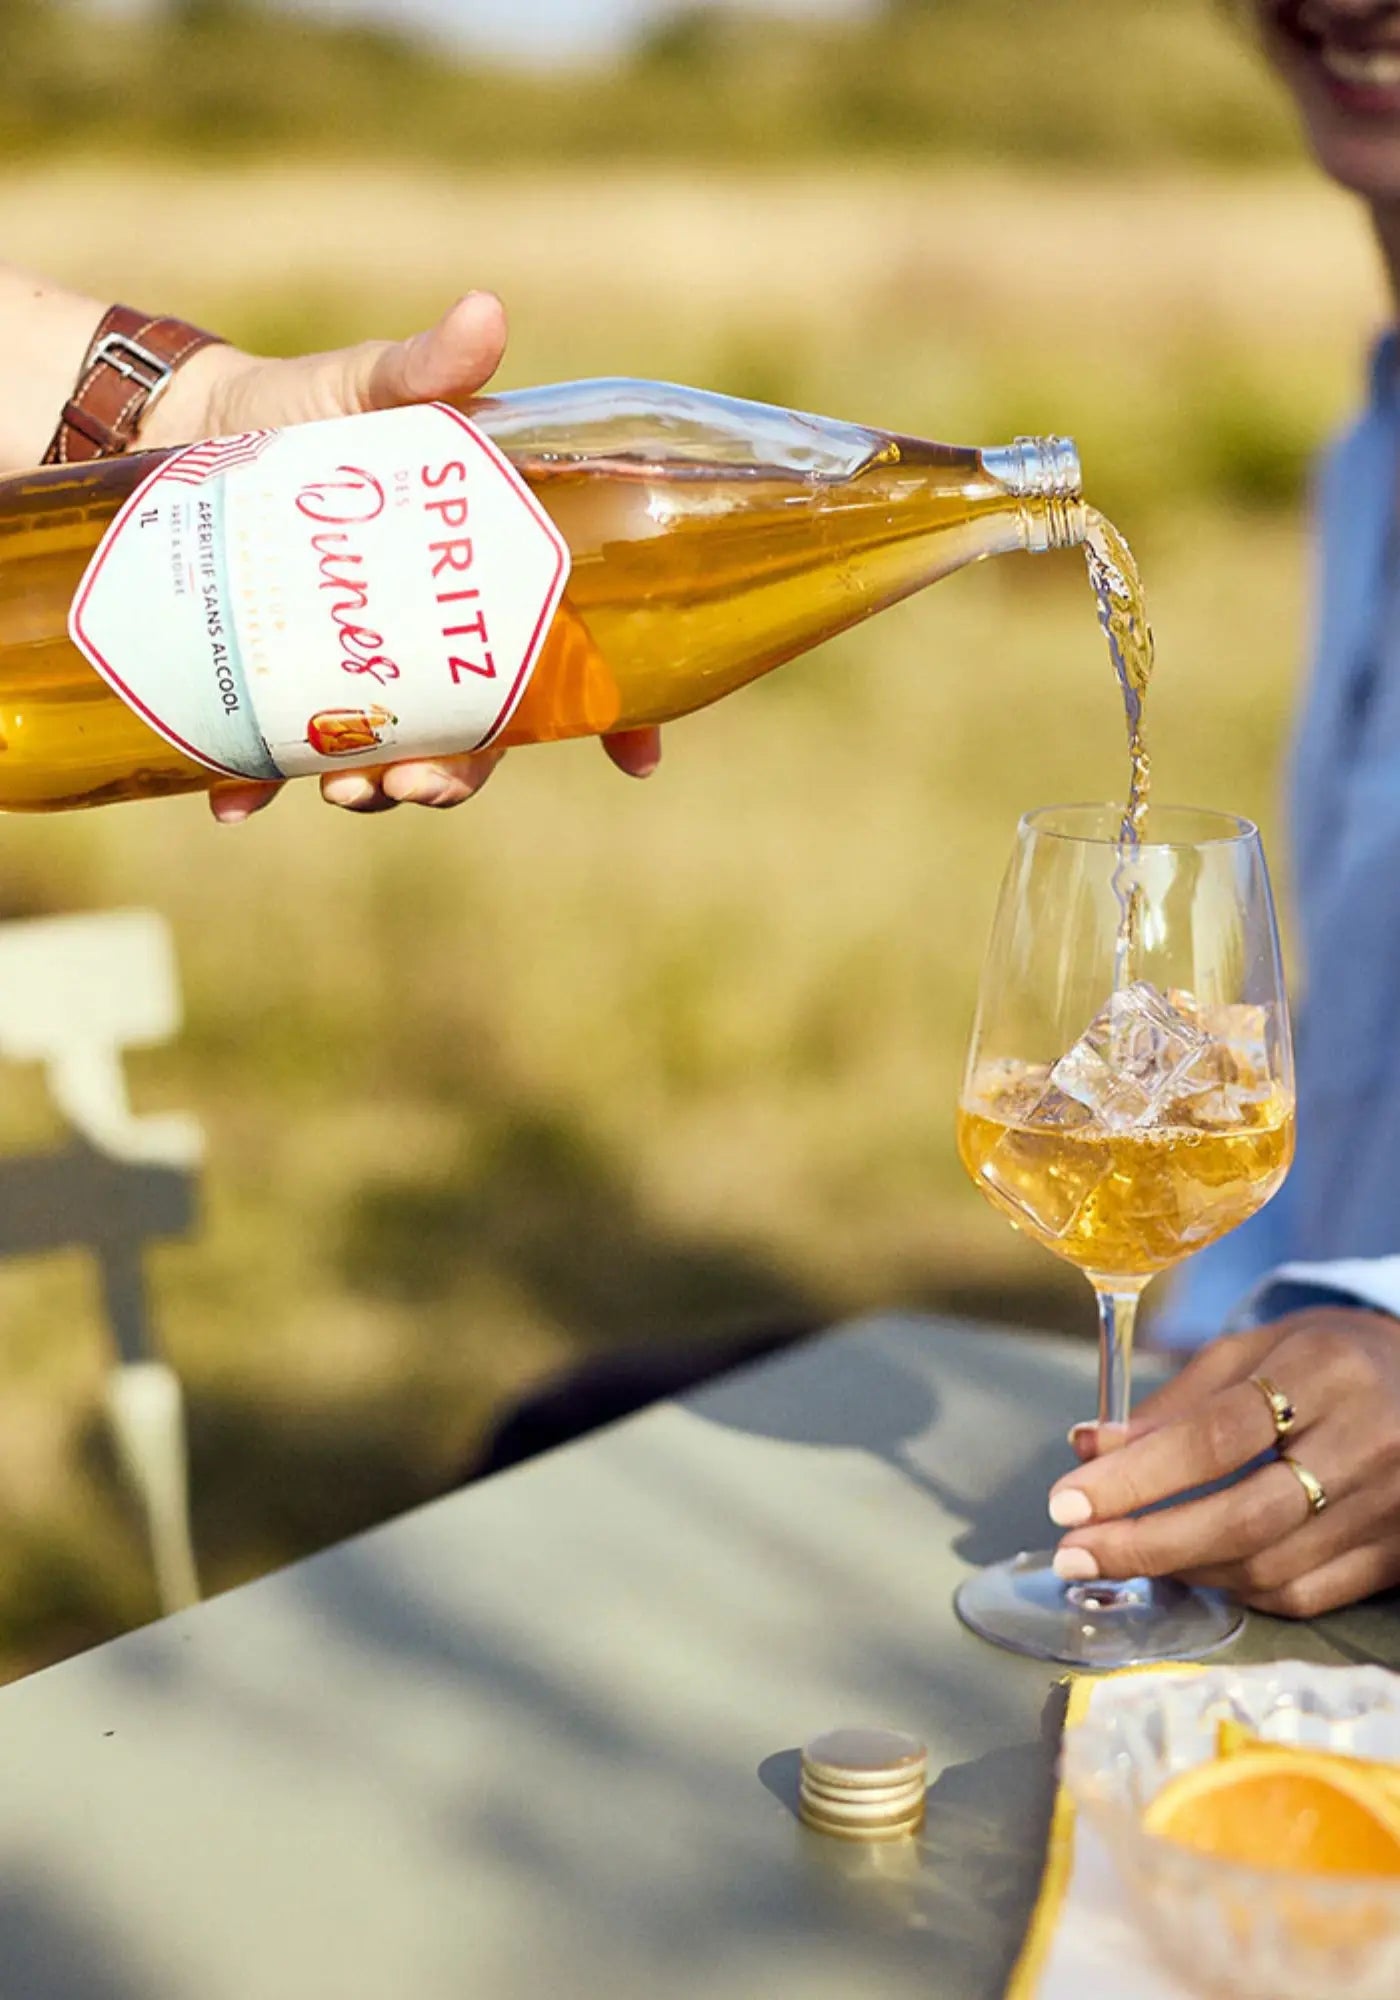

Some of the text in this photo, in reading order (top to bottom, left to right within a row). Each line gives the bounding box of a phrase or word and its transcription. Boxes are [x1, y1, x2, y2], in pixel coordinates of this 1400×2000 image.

[140, 508, 159, 528] 1L
[394, 470, 410, 507] DES
[295, 465, 400, 686] Dunes
[421, 461, 496, 684] SPRITZ
[202, 583, 225, 637] SANS
[211, 642, 240, 717] ALCOOL
